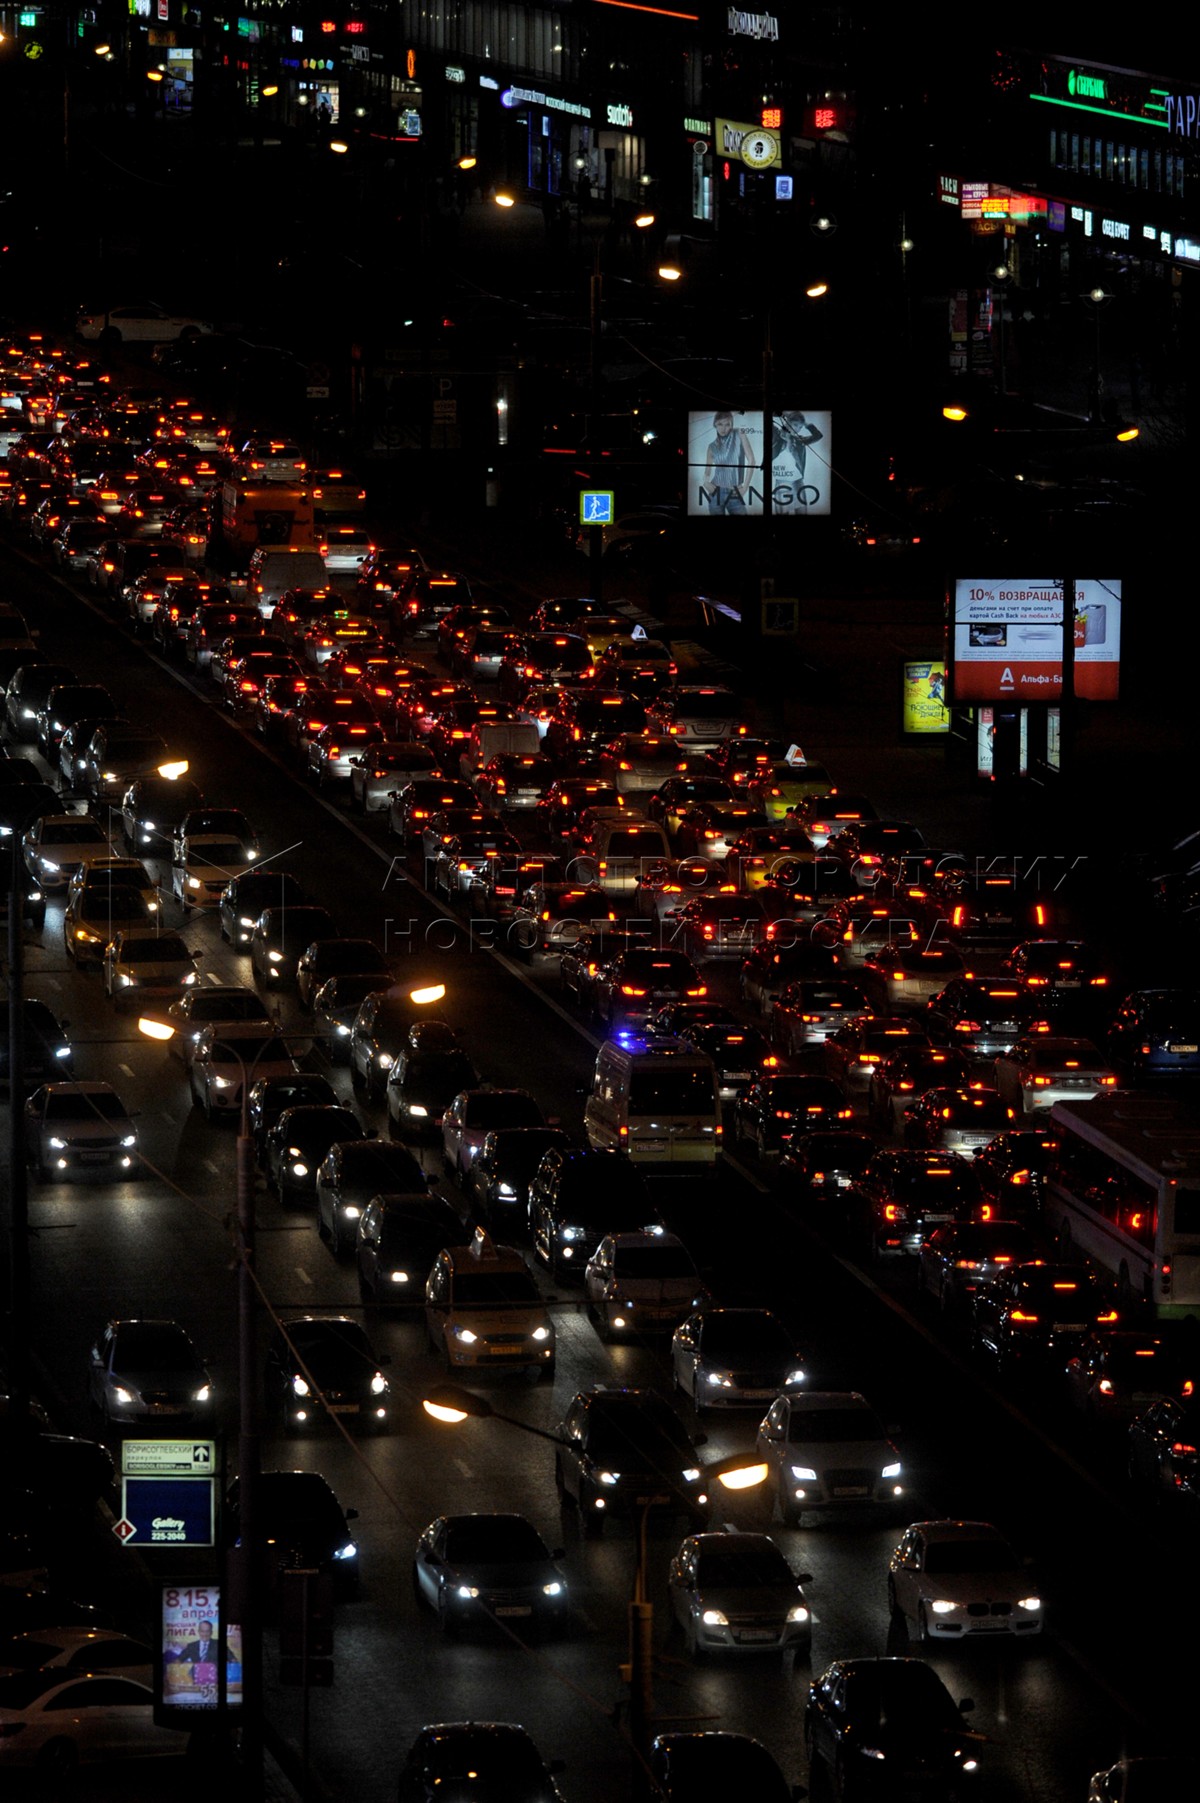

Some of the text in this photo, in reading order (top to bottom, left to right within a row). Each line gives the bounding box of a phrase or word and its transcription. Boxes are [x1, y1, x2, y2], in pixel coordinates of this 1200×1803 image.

[698, 485, 820, 506] MANGO
[969, 588, 995, 602] 10%
[969, 612, 989, 620] картой
[151, 1517, 185, 1531] Gallery
[151, 1532, 186, 1541] 225-2040
[166, 1629, 197, 1637] ЛИГА
